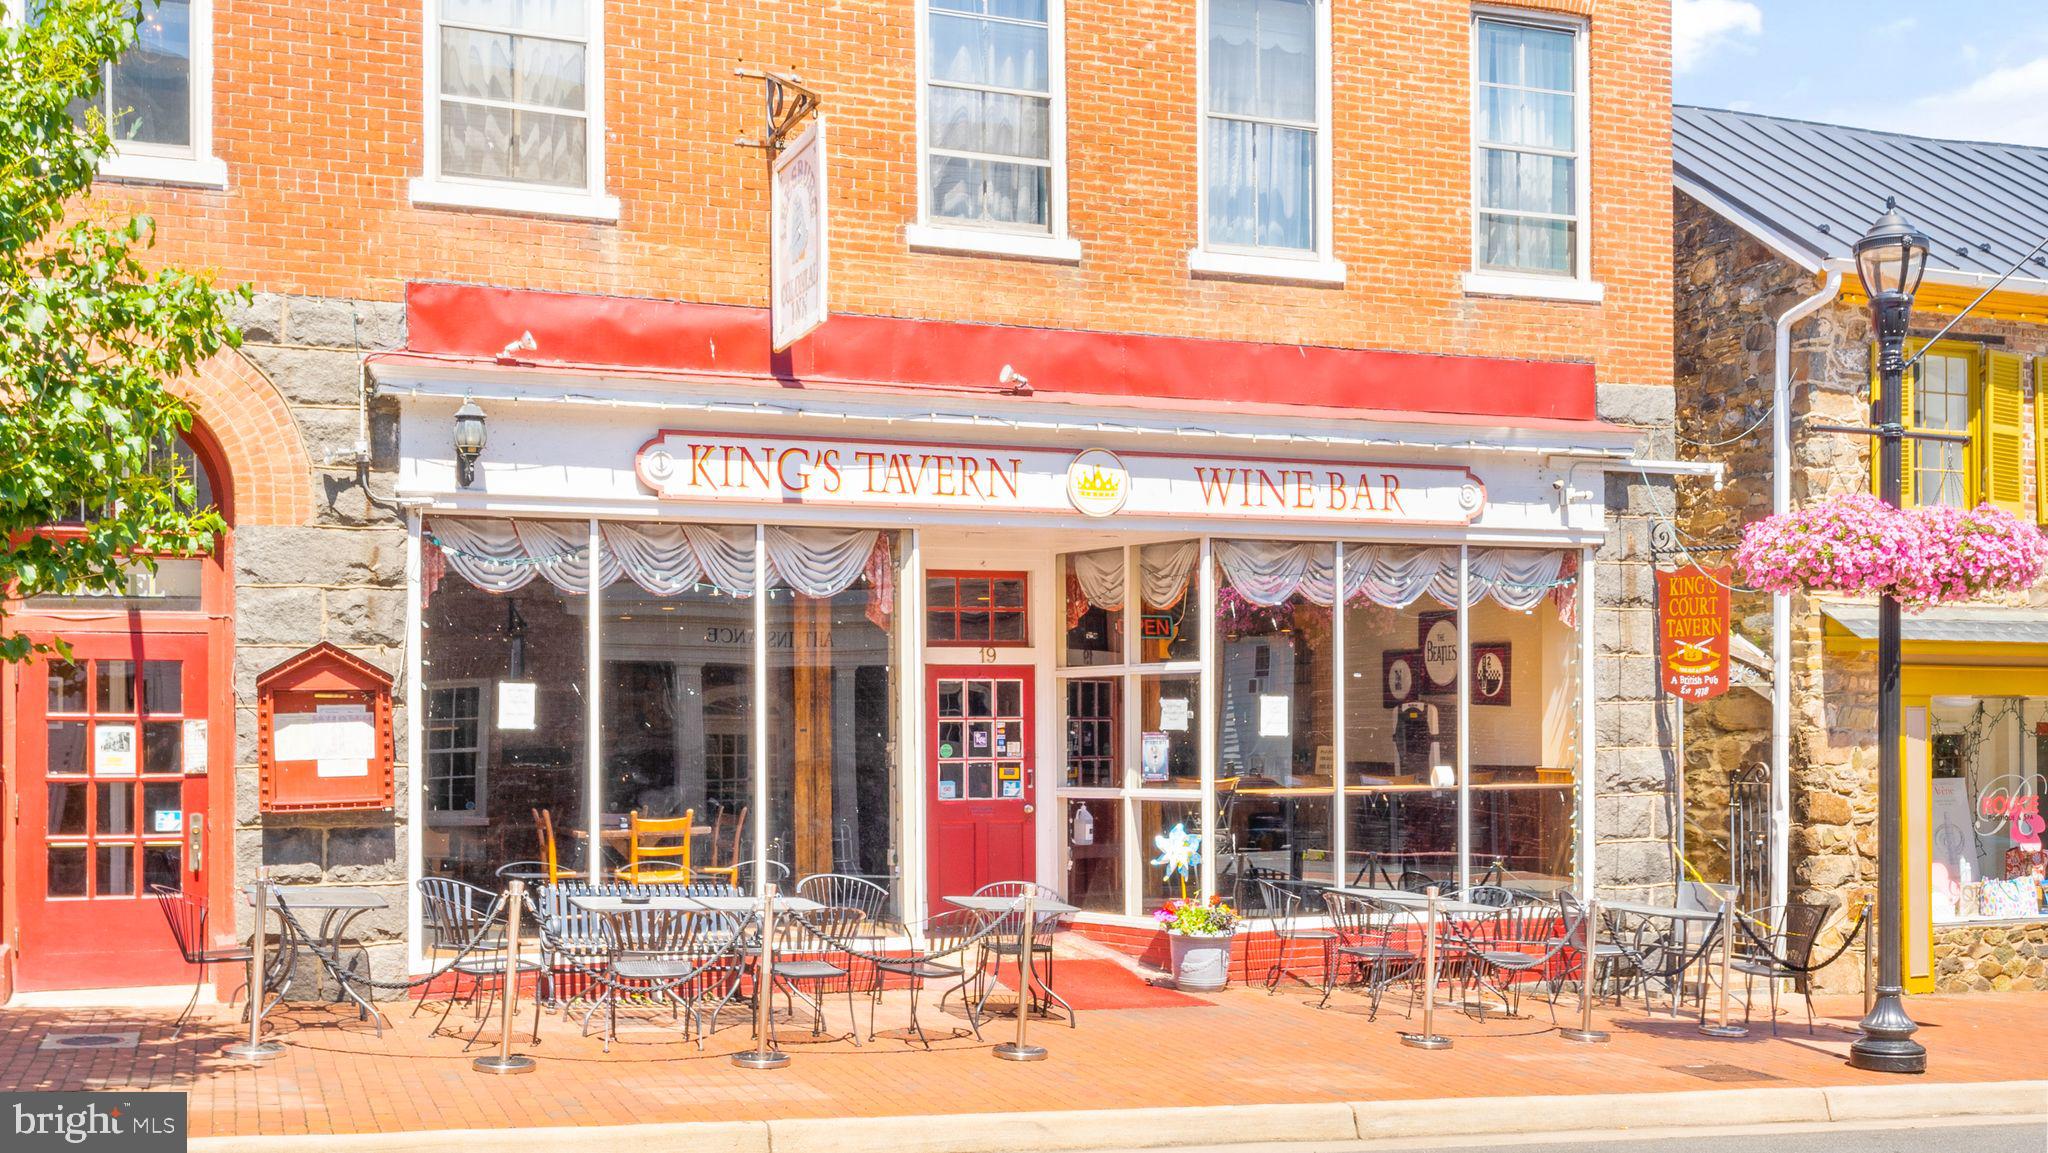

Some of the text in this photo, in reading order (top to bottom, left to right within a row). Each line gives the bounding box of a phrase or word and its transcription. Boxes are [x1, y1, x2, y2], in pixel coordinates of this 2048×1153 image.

[687, 443, 1022, 501] KING'S TAVERN
[1193, 466, 1406, 515] WINE BAR
[1669, 575, 1718, 596] KING'S
[1669, 597, 1719, 617] COURT
[1116, 618, 1171, 636] OEN
[1666, 617, 1722, 638] TAVERN
[1437, 633, 1446, 642] THE
[978, 647, 997, 664] 19
[1427, 641, 1457, 665] BEATLES
[1670, 676, 1678, 685] A
[1982, 795, 2039, 815] ROUGE
